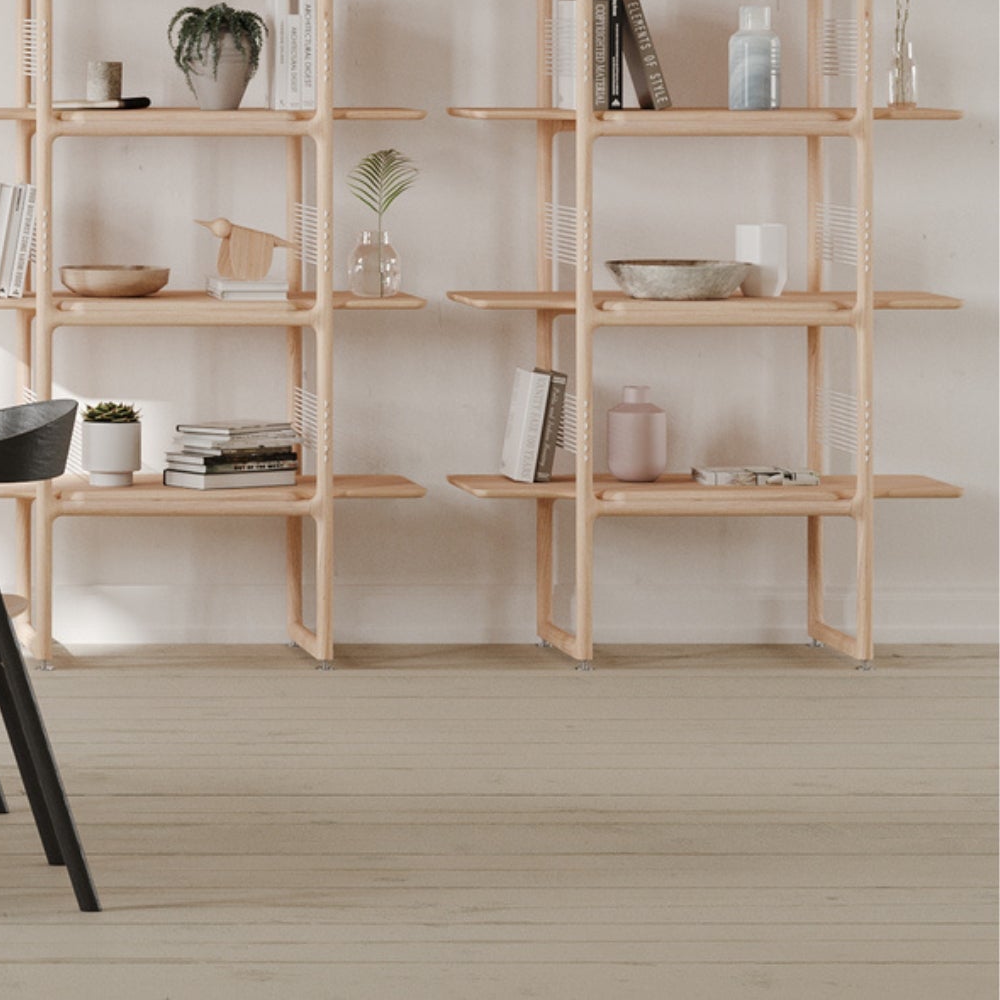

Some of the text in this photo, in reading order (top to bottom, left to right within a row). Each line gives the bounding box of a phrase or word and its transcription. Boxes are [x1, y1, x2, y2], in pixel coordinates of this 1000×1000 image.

[303, 4, 312, 88] ARCHITECTURAL DIGEST
[595, 3, 606, 106] COPYRIGHTED MATERIAL
[627, 1, 669, 104] ELEMENTS OF STYLE
